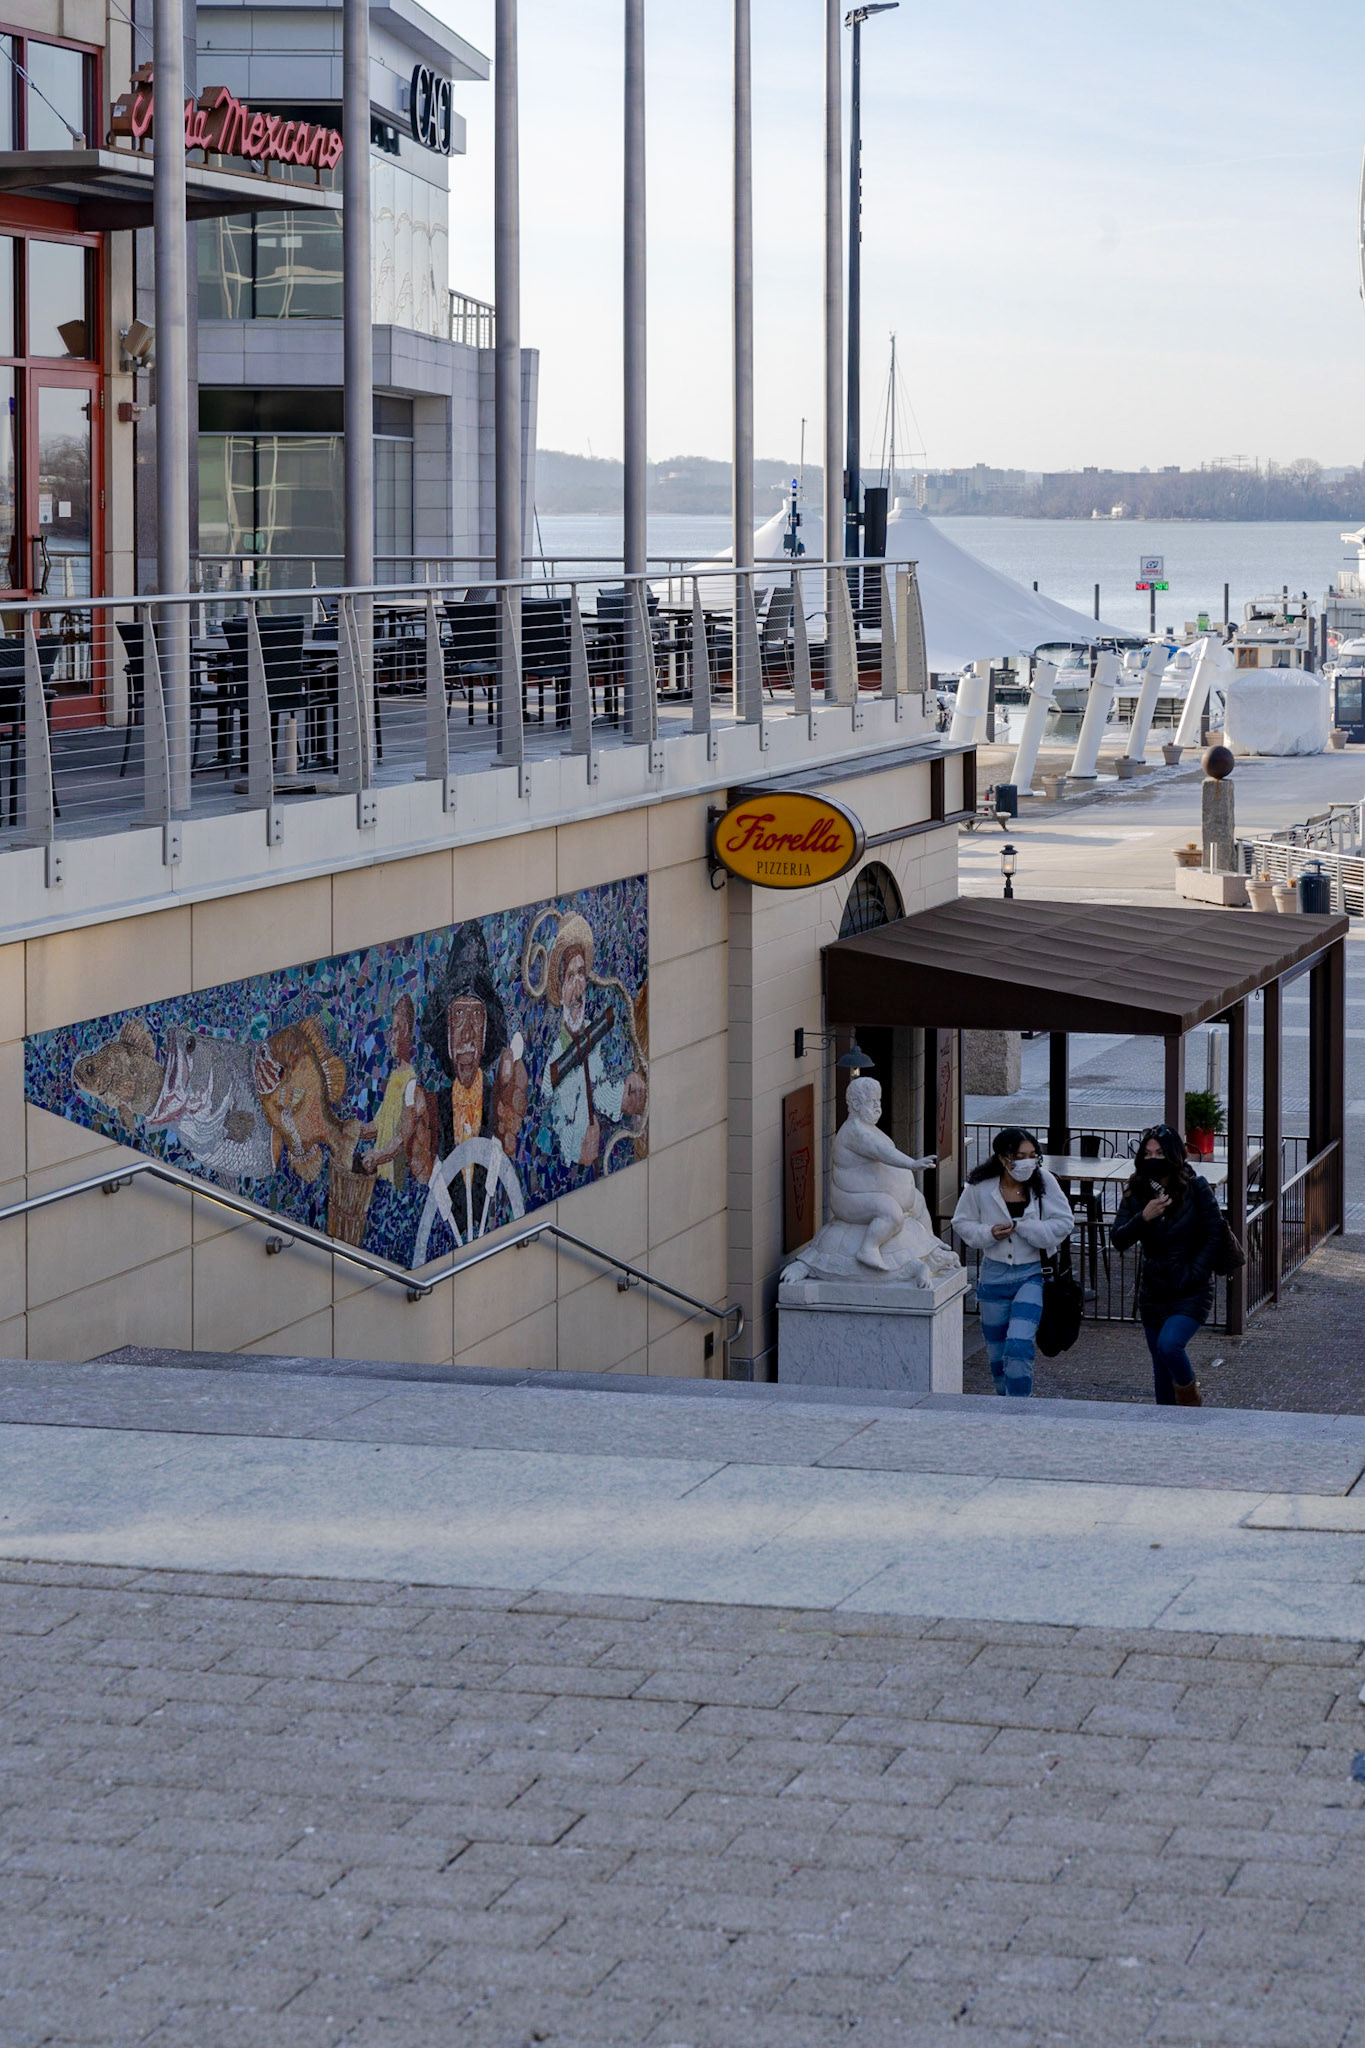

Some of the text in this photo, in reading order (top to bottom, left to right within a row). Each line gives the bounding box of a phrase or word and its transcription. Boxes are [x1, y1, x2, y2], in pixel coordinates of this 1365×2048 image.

[215, 86, 344, 169] Mexicano
[726, 814, 845, 853] Fiorella
[756, 861, 811, 876] PIZZERIA
